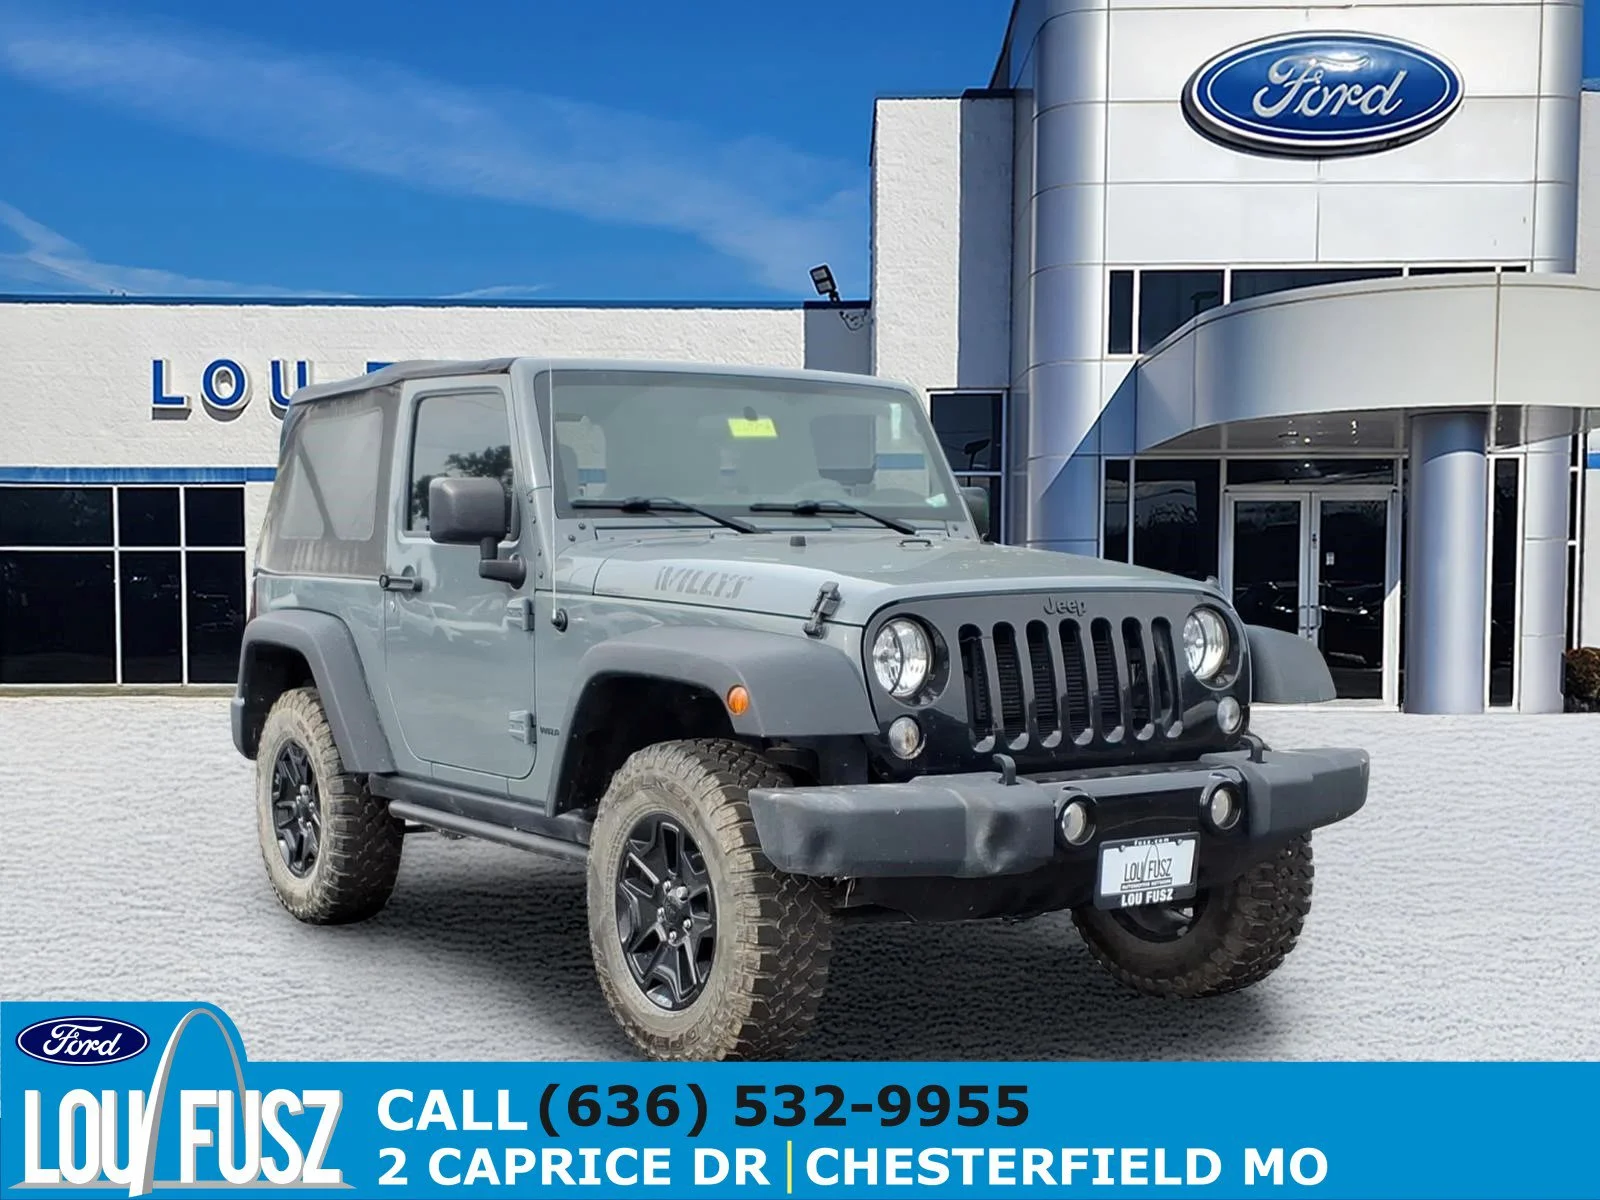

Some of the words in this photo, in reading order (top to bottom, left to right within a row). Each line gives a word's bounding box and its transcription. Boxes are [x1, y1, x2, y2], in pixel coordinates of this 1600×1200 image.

[1252, 54, 1407, 118] Ford
[152, 358, 308, 409] LOU
[654, 566, 753, 599] WILLYS
[1042, 594, 1086, 617] Jeep
[1124, 861, 1145, 882] LOU
[1147, 858, 1173, 880] FUSZ
[1121, 892, 1143, 907] LOU
[1145, 888, 1174, 904] FUSZ
